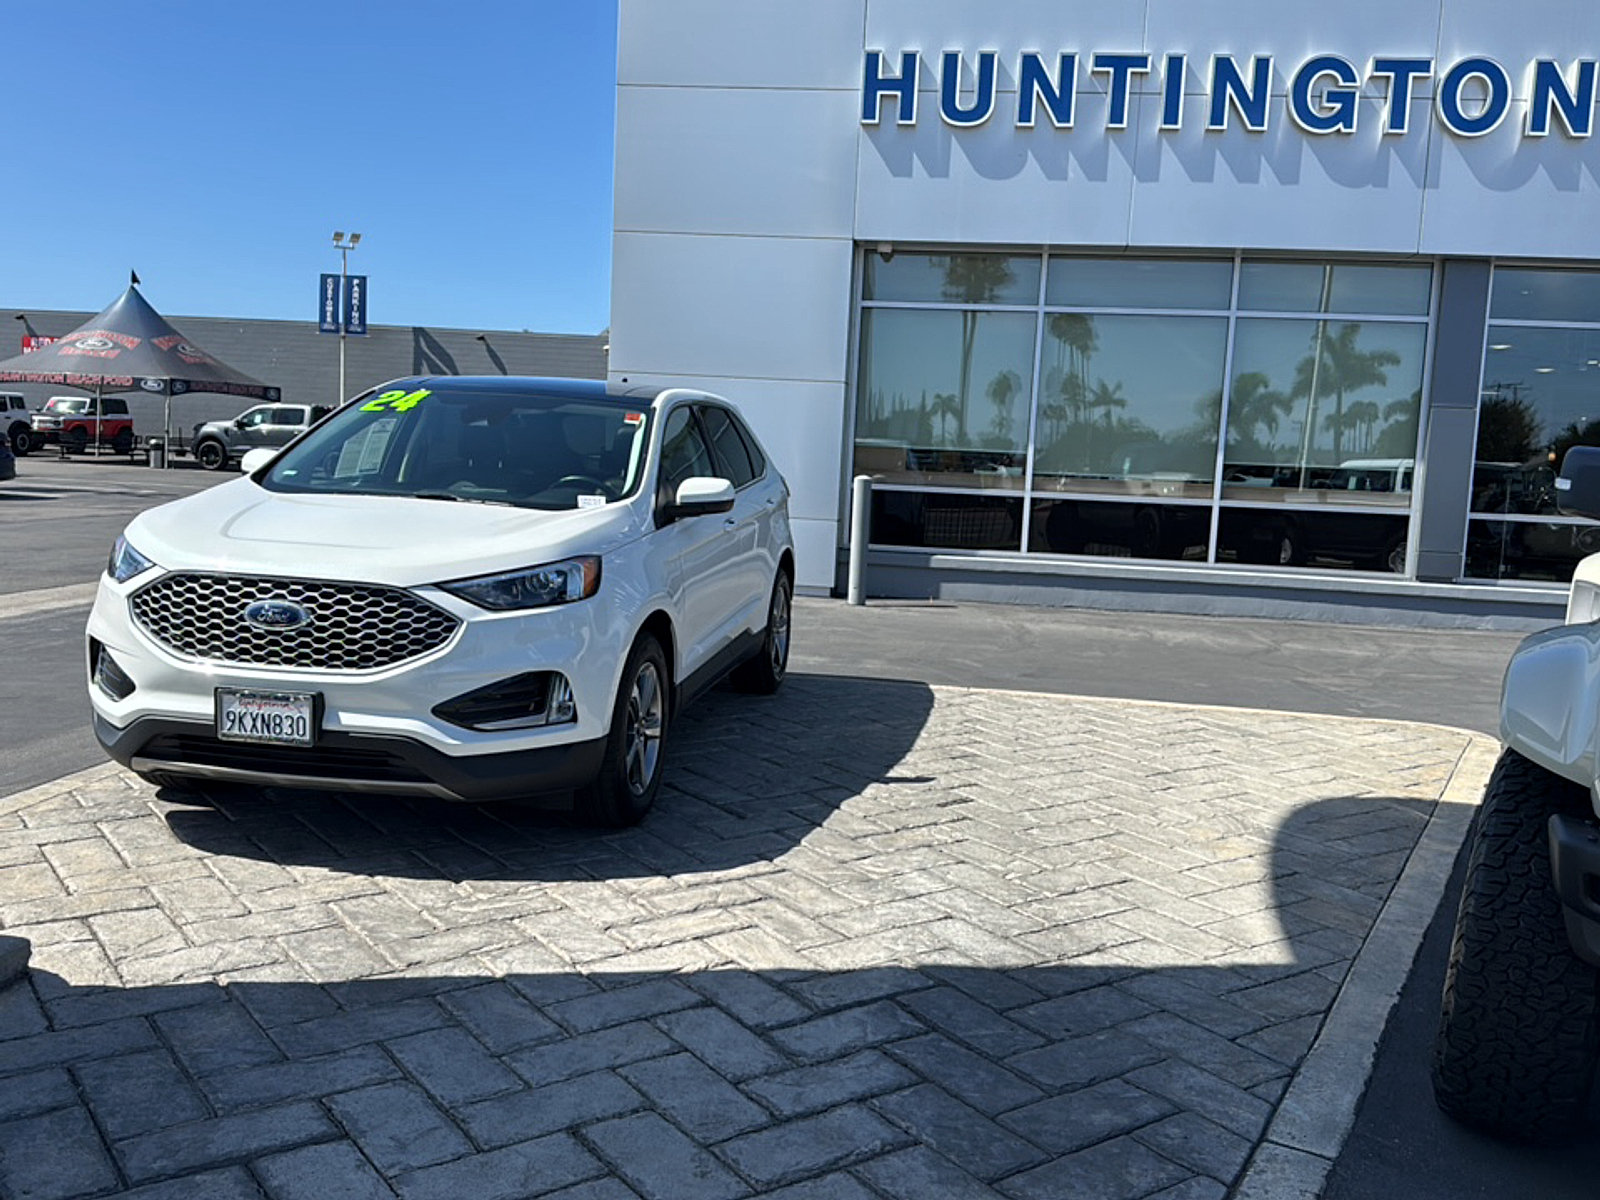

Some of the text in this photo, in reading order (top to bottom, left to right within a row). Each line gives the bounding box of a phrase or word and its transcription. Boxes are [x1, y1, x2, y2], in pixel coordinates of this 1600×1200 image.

[860, 50, 1599, 137] HUNTINGTON
[351, 278, 360, 325] PARKING
[359, 389, 432, 412] 24
[226, 709, 307, 738] 9KXN830
